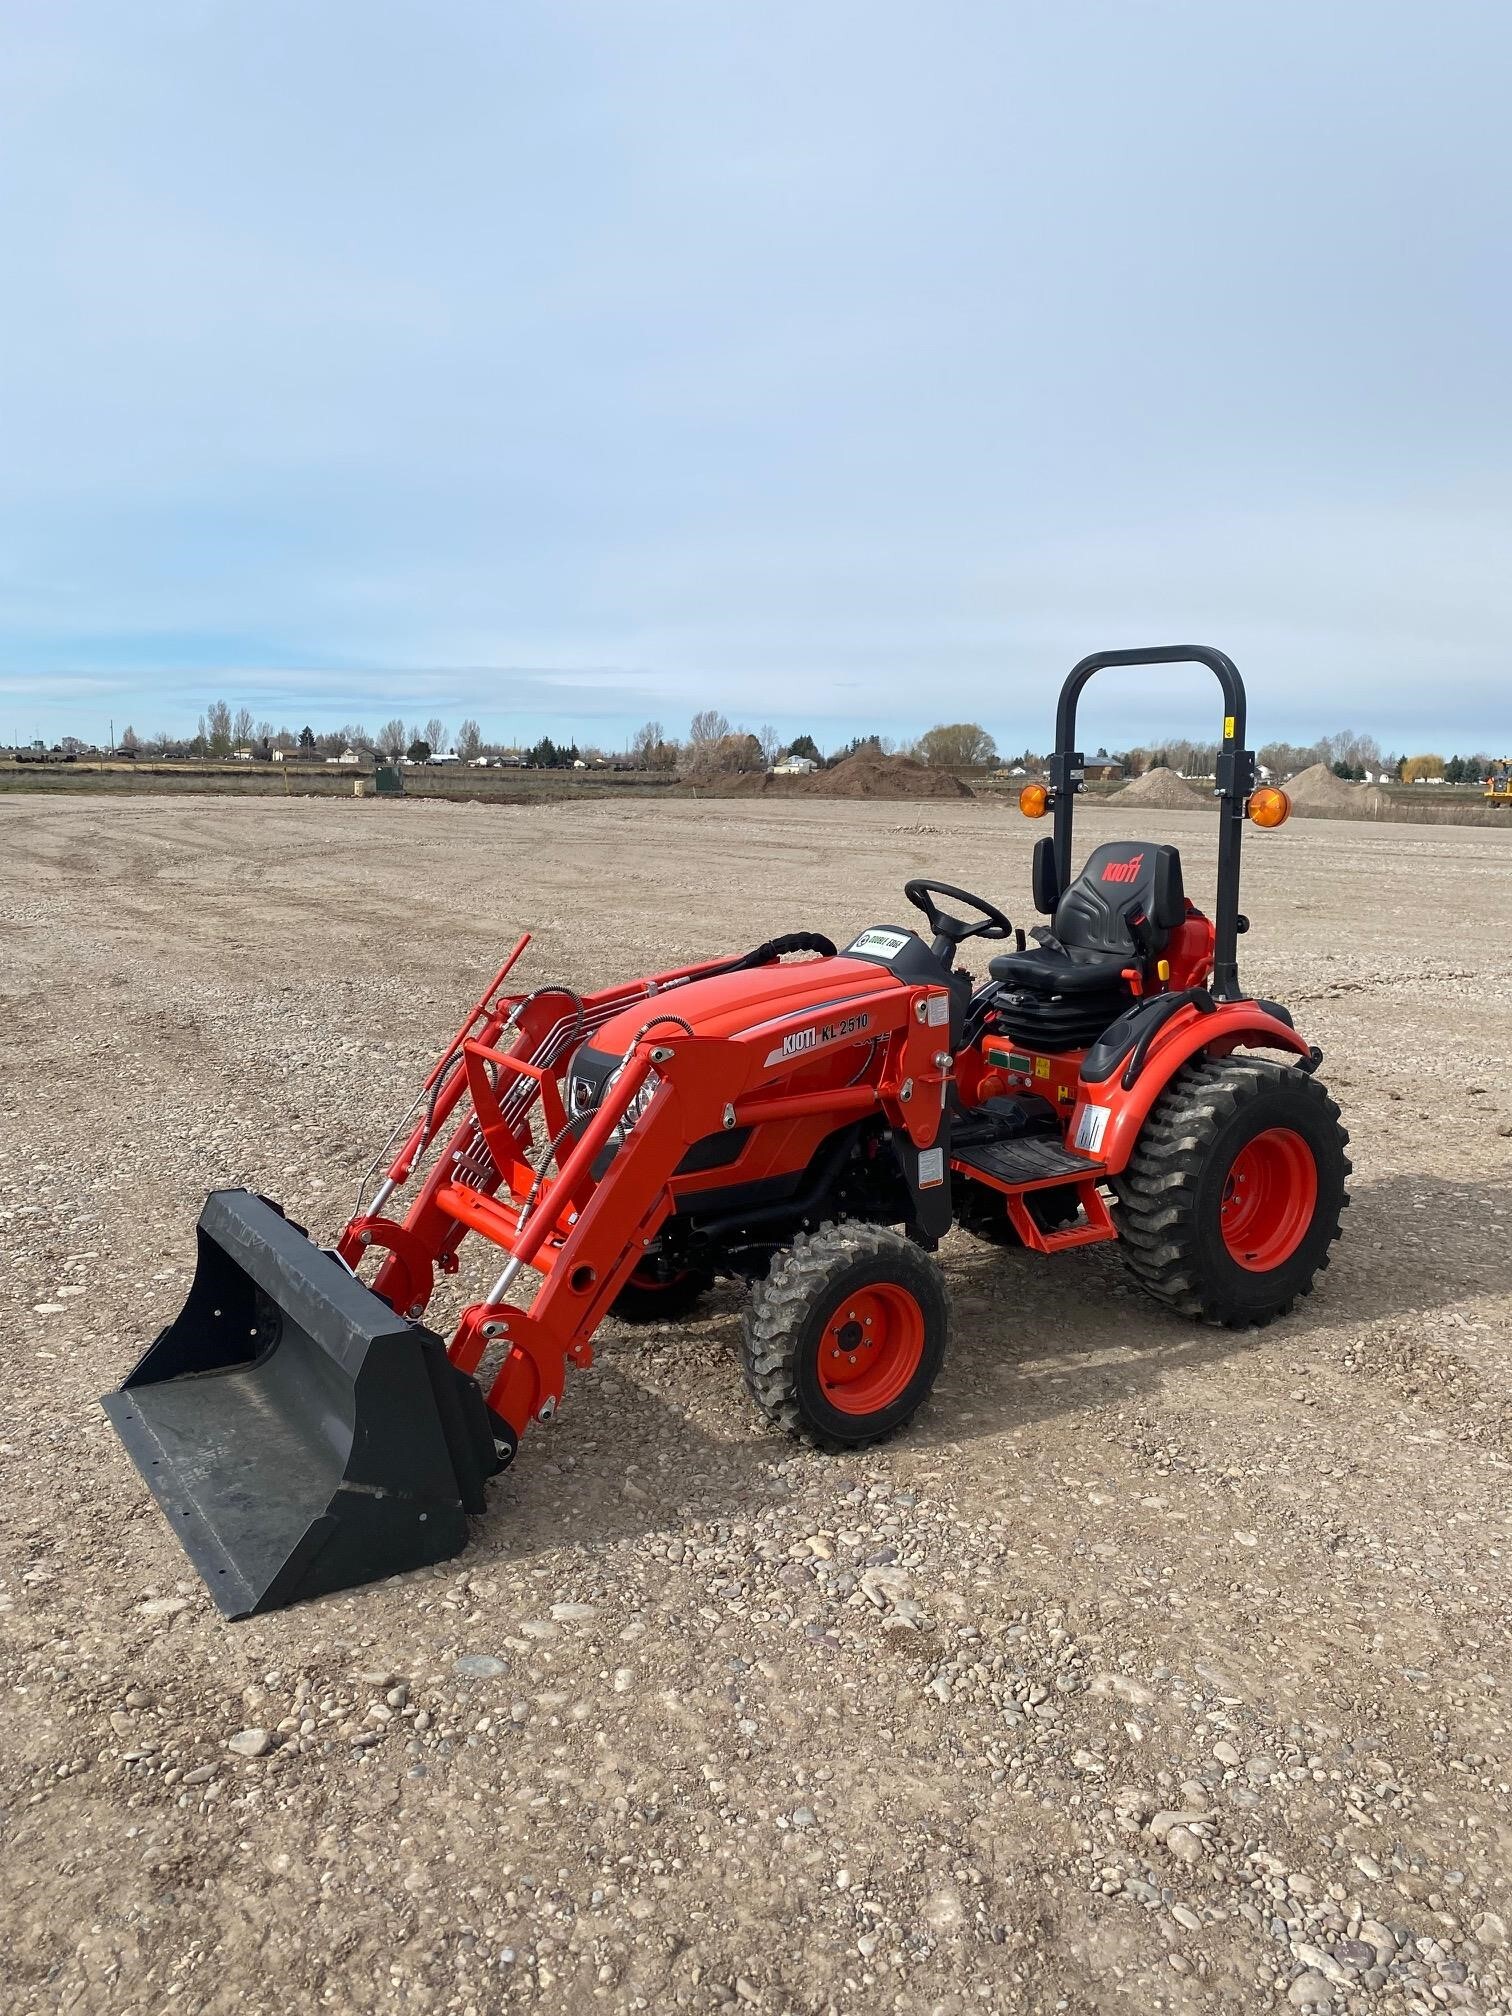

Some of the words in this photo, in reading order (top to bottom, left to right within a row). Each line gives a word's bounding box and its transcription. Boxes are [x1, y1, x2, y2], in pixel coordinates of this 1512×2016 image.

[1101, 860, 1141, 883] KIOTI
[782, 1026, 817, 1057] KIOTI
[821, 1024, 837, 1042] KL
[839, 1013, 869, 1035] 2510
